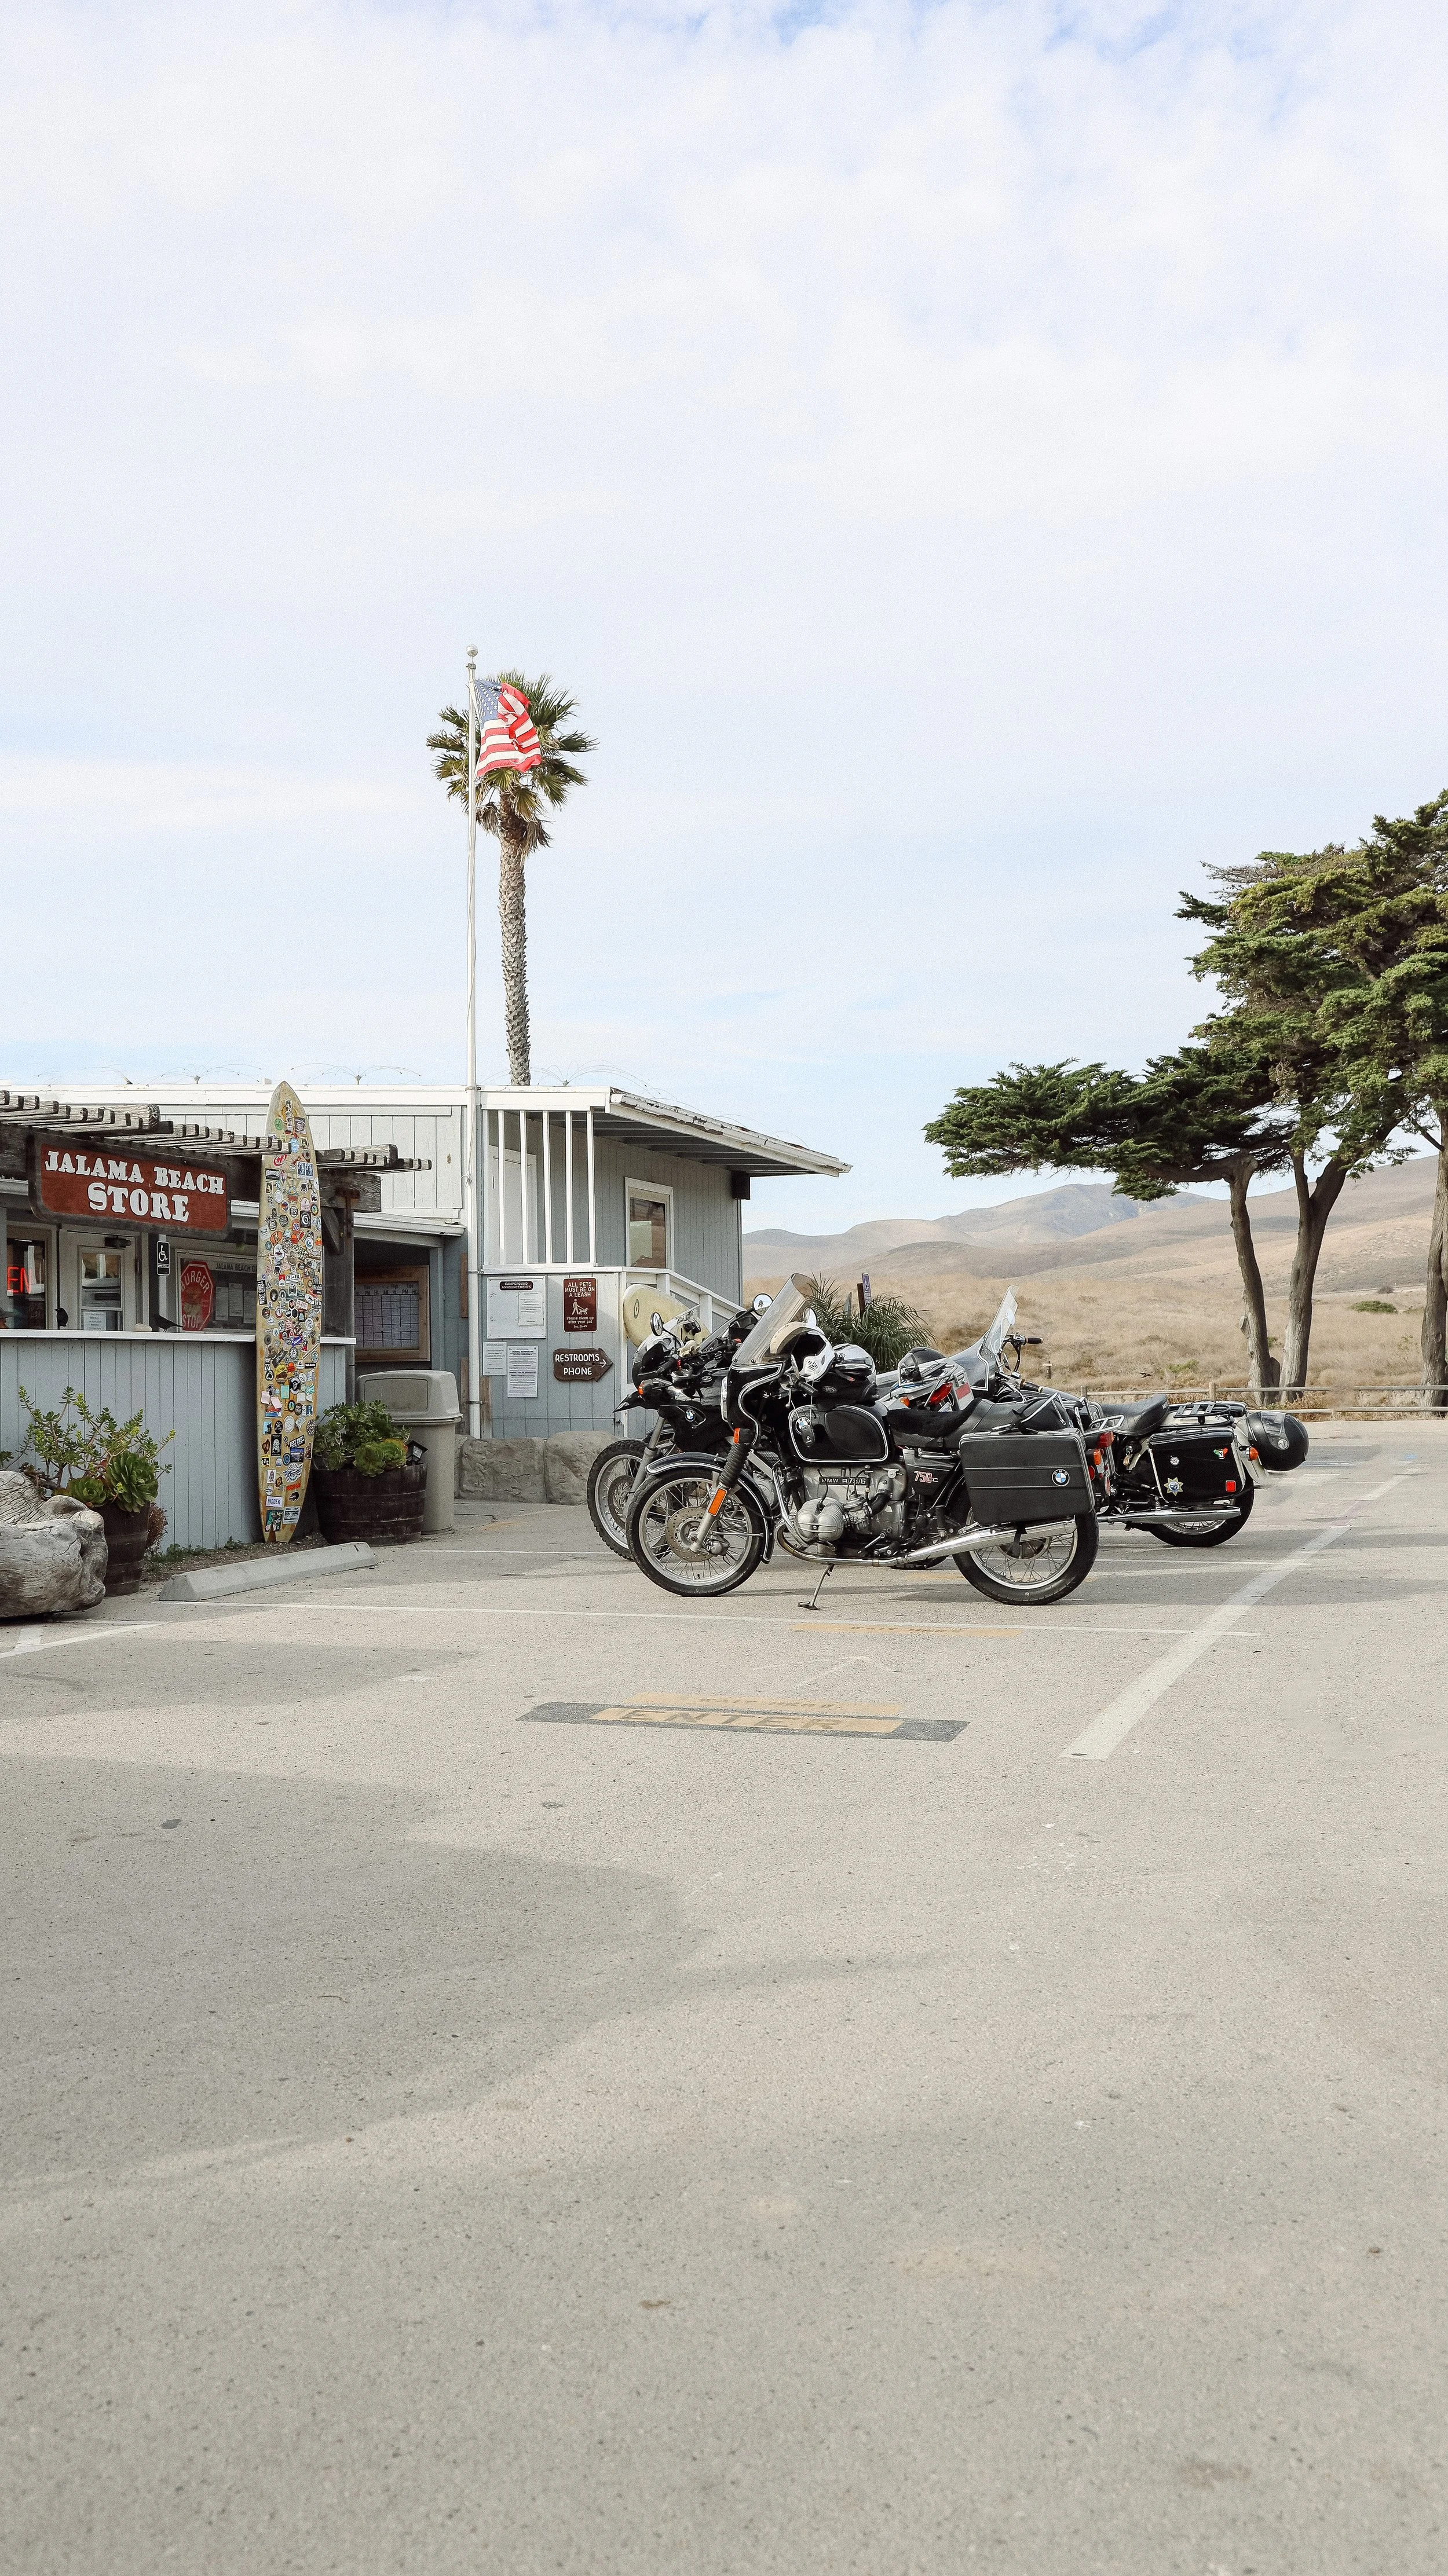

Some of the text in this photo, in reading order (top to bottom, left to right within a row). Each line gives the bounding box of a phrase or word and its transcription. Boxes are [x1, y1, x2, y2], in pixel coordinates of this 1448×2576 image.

[45, 1150, 225, 1195] JALAMA BEACH
[87, 1182, 189, 1222] STORE
[235, 1263, 250, 1272] BEACH
[181, 1270, 210, 1294] BURGER
[555, 1353, 600, 1362] RESTROOMS
[564, 1367, 593, 1376] PHONE
[620, 1709, 842, 1729] ENTER
